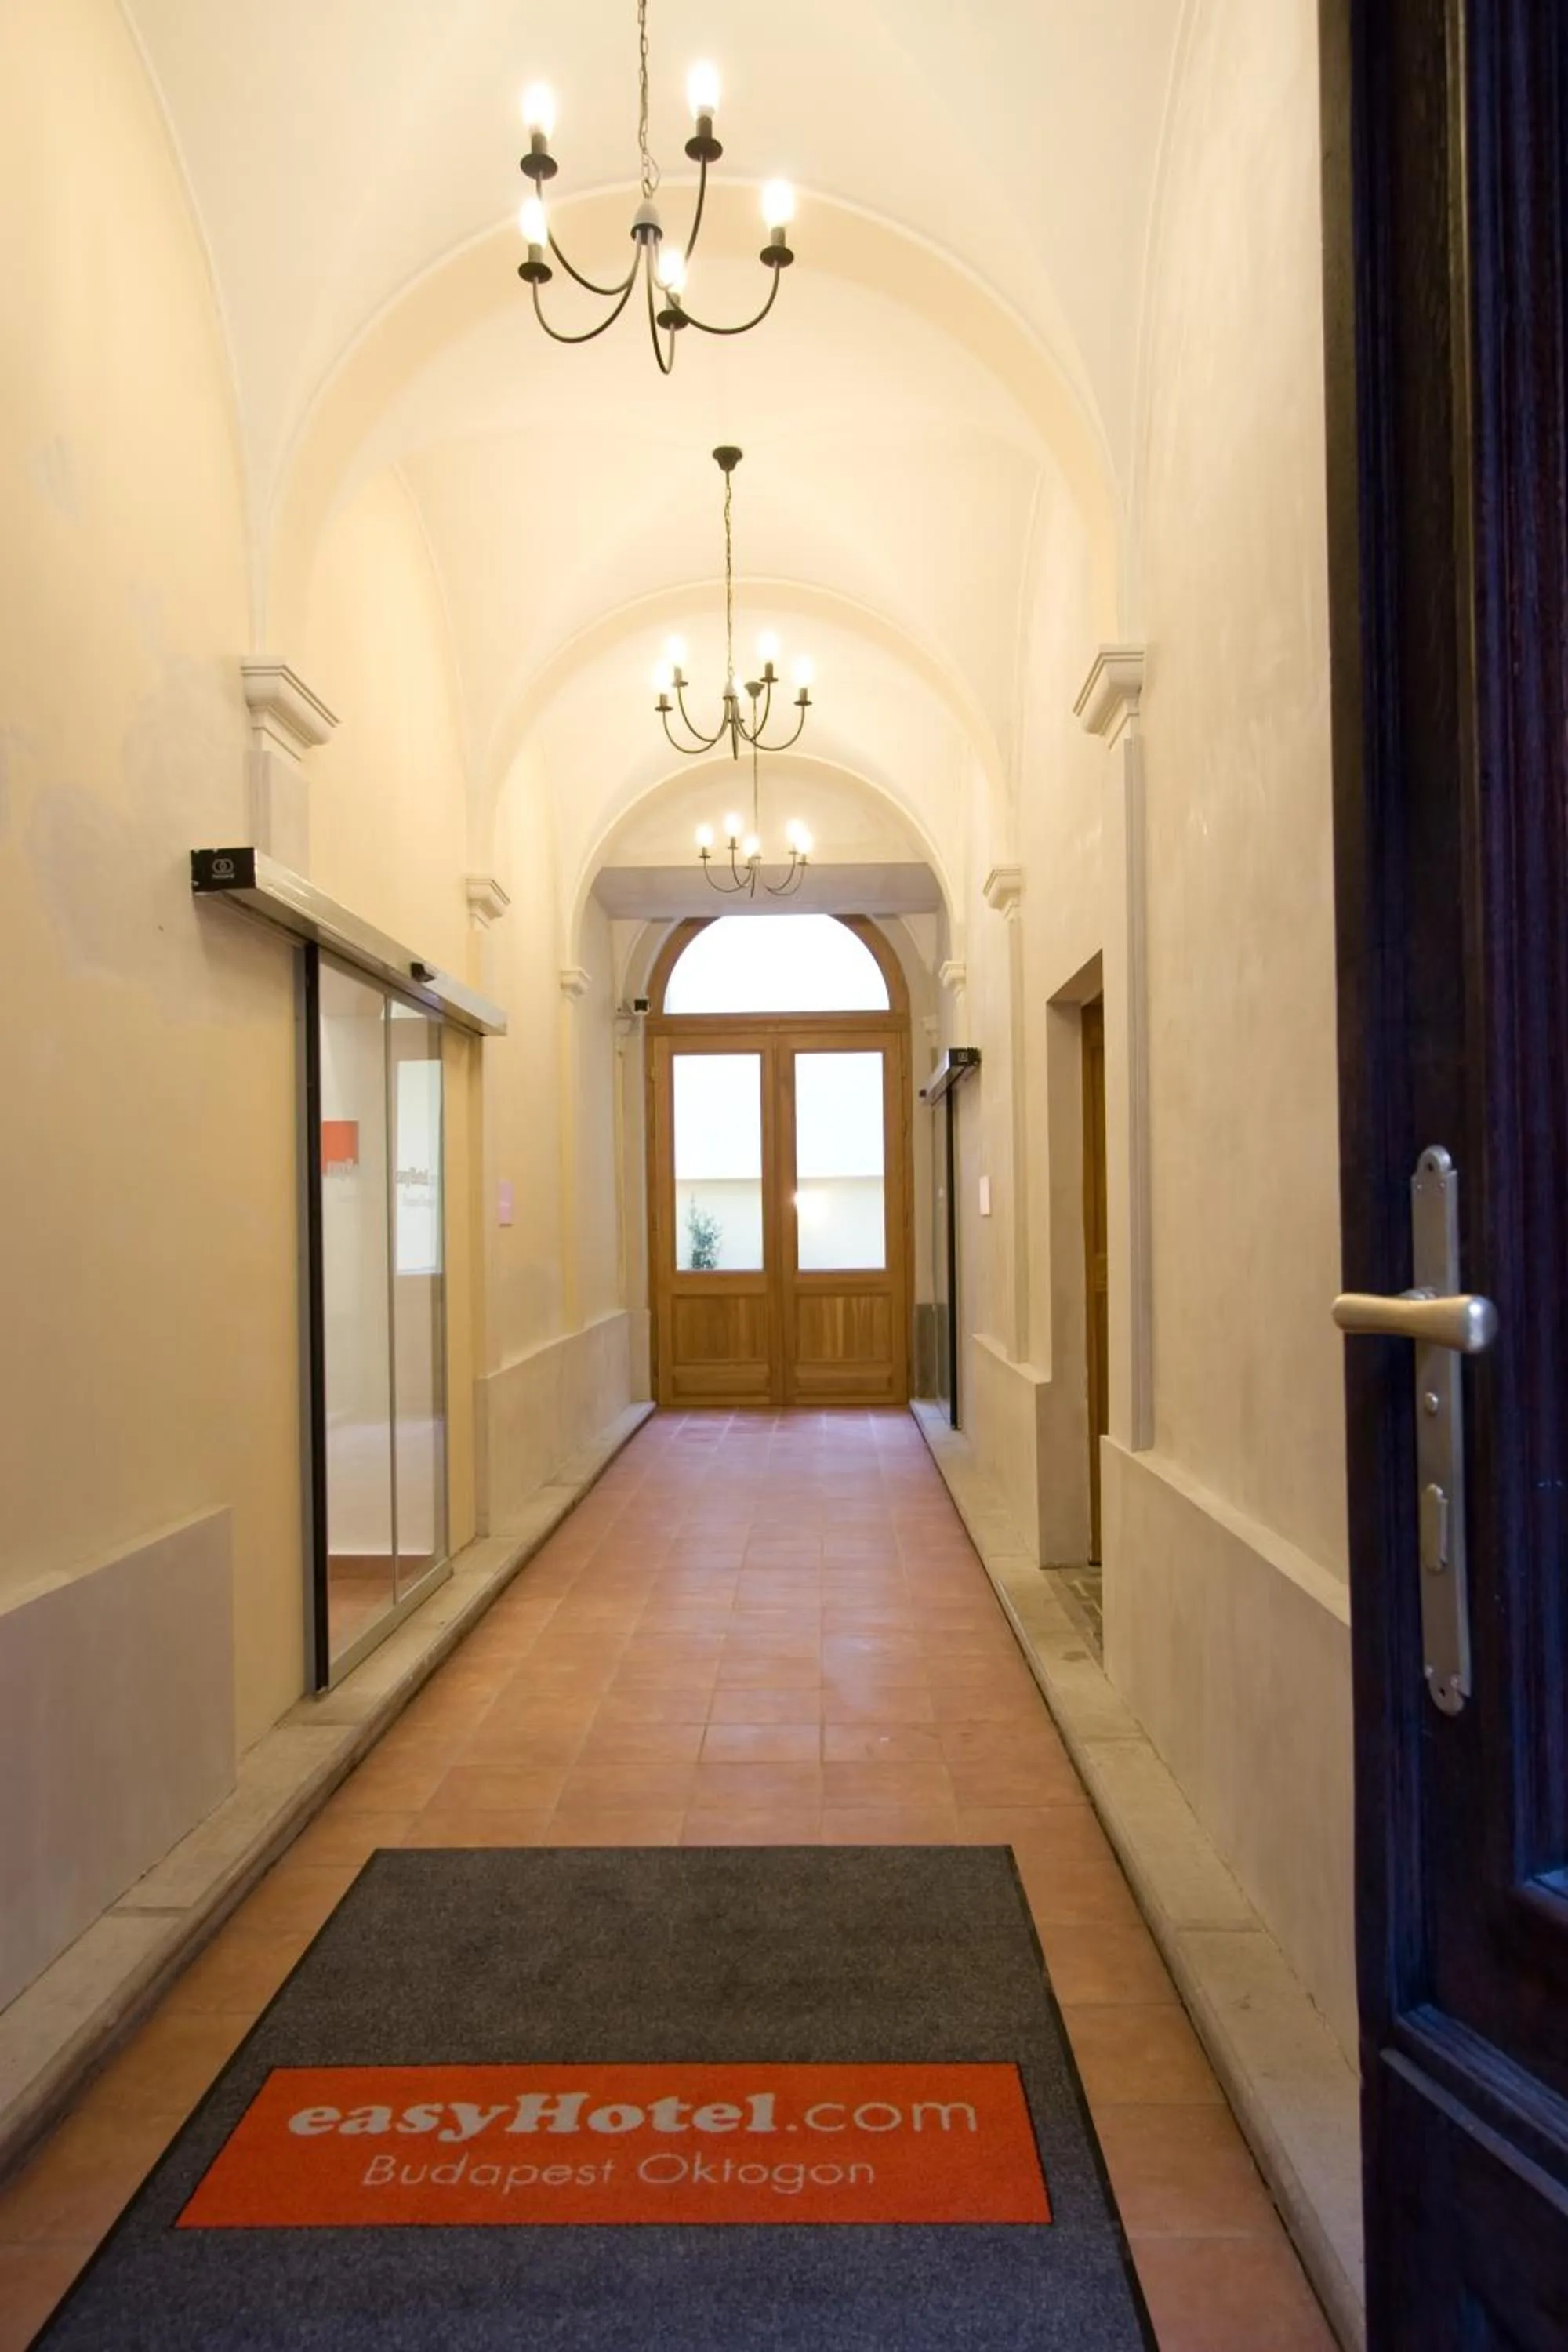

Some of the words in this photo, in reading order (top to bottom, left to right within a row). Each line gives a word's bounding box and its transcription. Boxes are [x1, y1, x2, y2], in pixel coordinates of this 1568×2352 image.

[288, 2092, 978, 2143] easyHotel.com
[361, 2151, 614, 2195] Budapest
[637, 2151, 875, 2194] Oktogon
